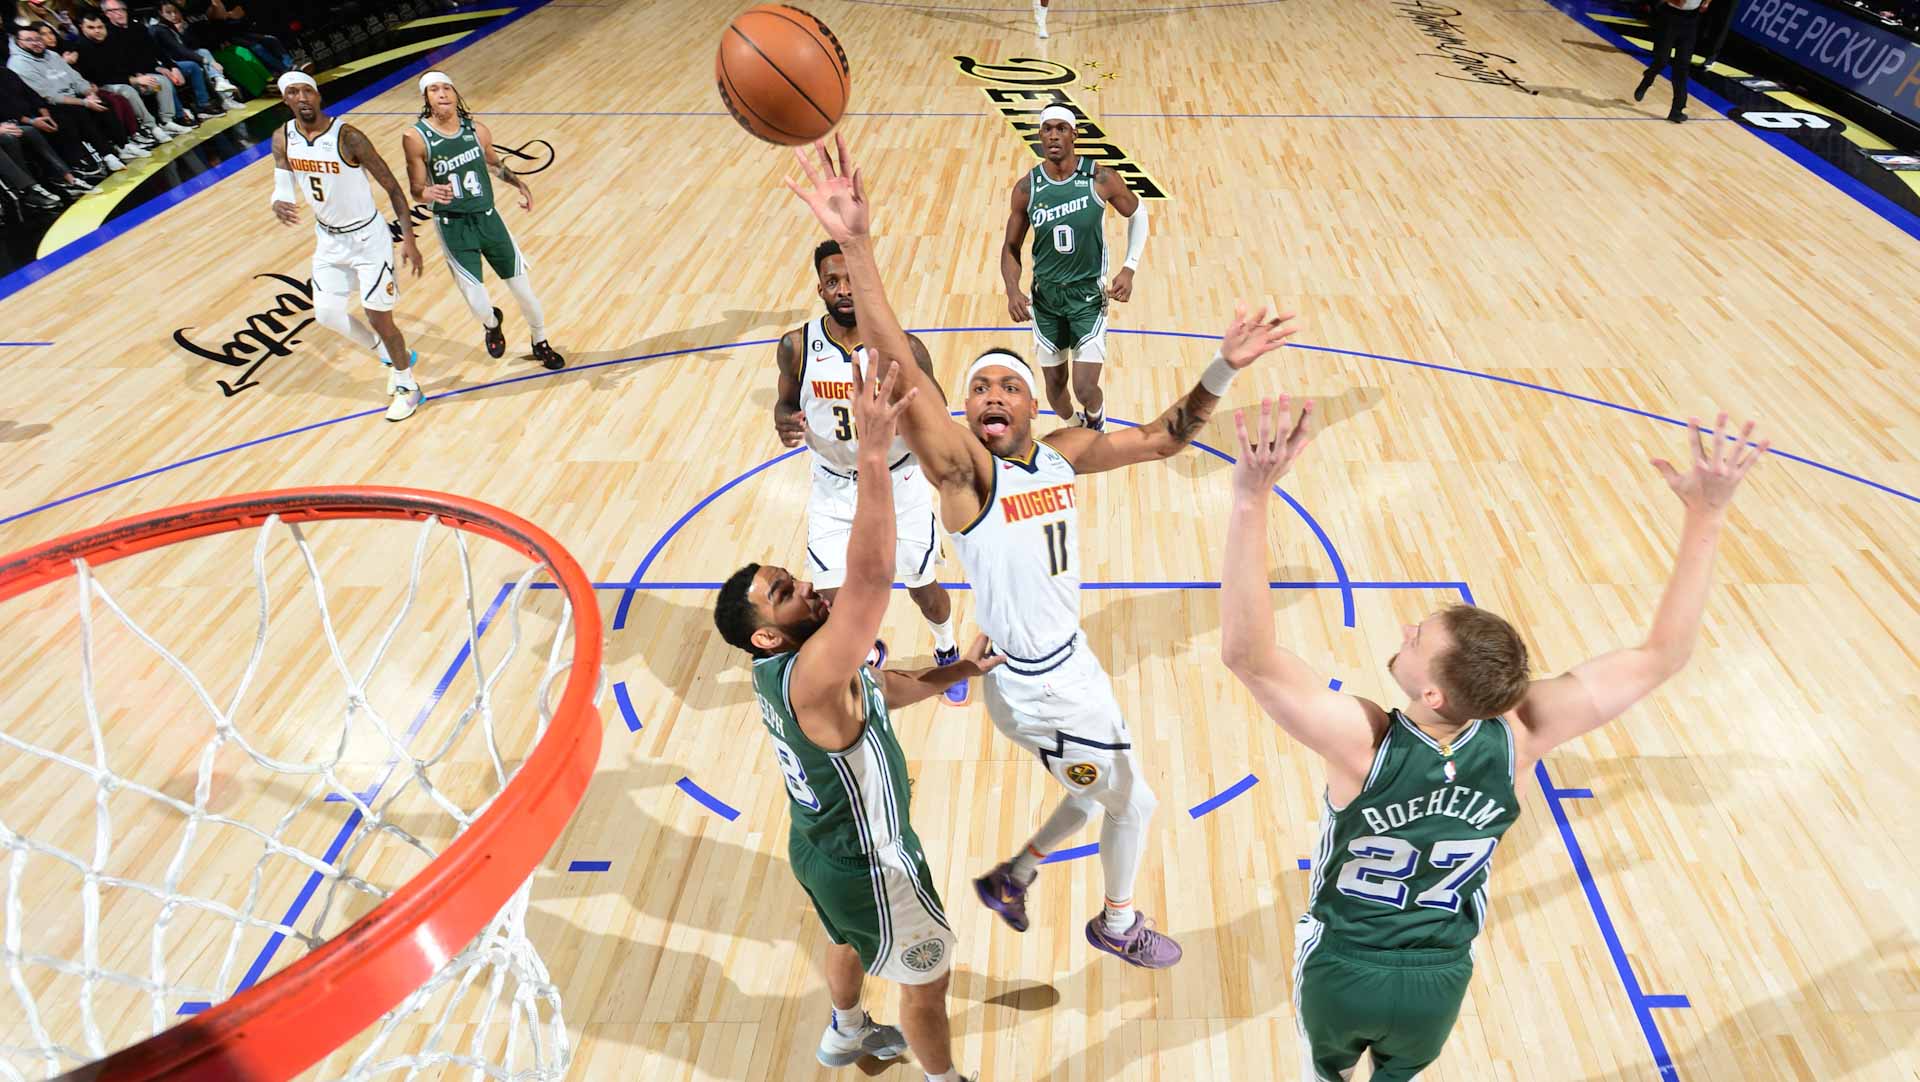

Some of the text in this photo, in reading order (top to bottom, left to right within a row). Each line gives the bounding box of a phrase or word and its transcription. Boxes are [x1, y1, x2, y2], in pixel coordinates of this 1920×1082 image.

[1741, 0, 1906, 85] FREE PICKUP
[433, 147, 480, 176] DETROIT
[309, 176, 325, 202] 5
[448, 171, 483, 199] 14
[1033, 196, 1088, 228] DETROIT
[1053, 225, 1075, 254] 0
[832, 405, 859, 441] 3
[1000, 483, 1075, 523] NUGGET
[1043, 520, 1068, 576] 11
[1361, 785, 1506, 835] BOEHEIM
[1336, 836, 1498, 913] 27
